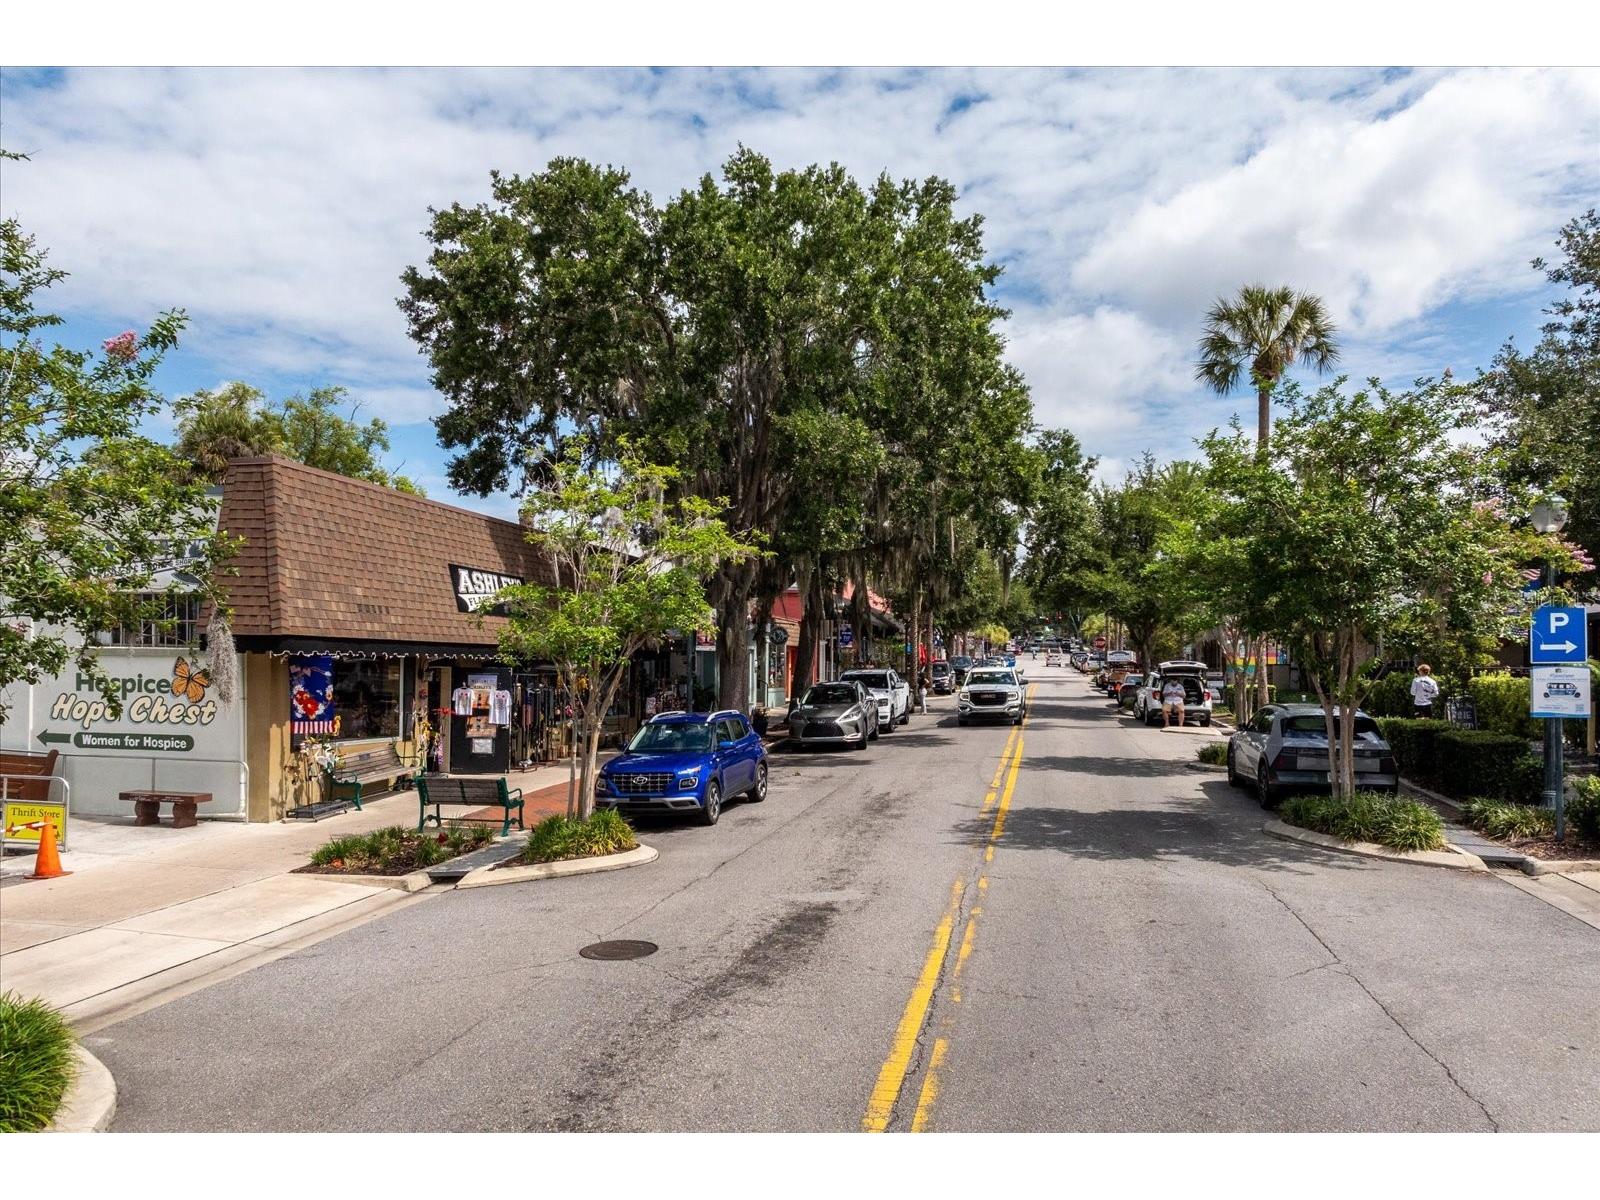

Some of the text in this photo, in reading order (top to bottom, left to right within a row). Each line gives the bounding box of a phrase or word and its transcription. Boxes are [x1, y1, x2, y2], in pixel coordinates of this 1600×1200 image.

[1550, 612, 1569, 634] P
[75, 672, 171, 700] Hospice
[51, 692, 218, 729] Hope Chest
[82, 734, 187, 749] Women for Hospice
[11, 807, 61, 819] Thrift Store
